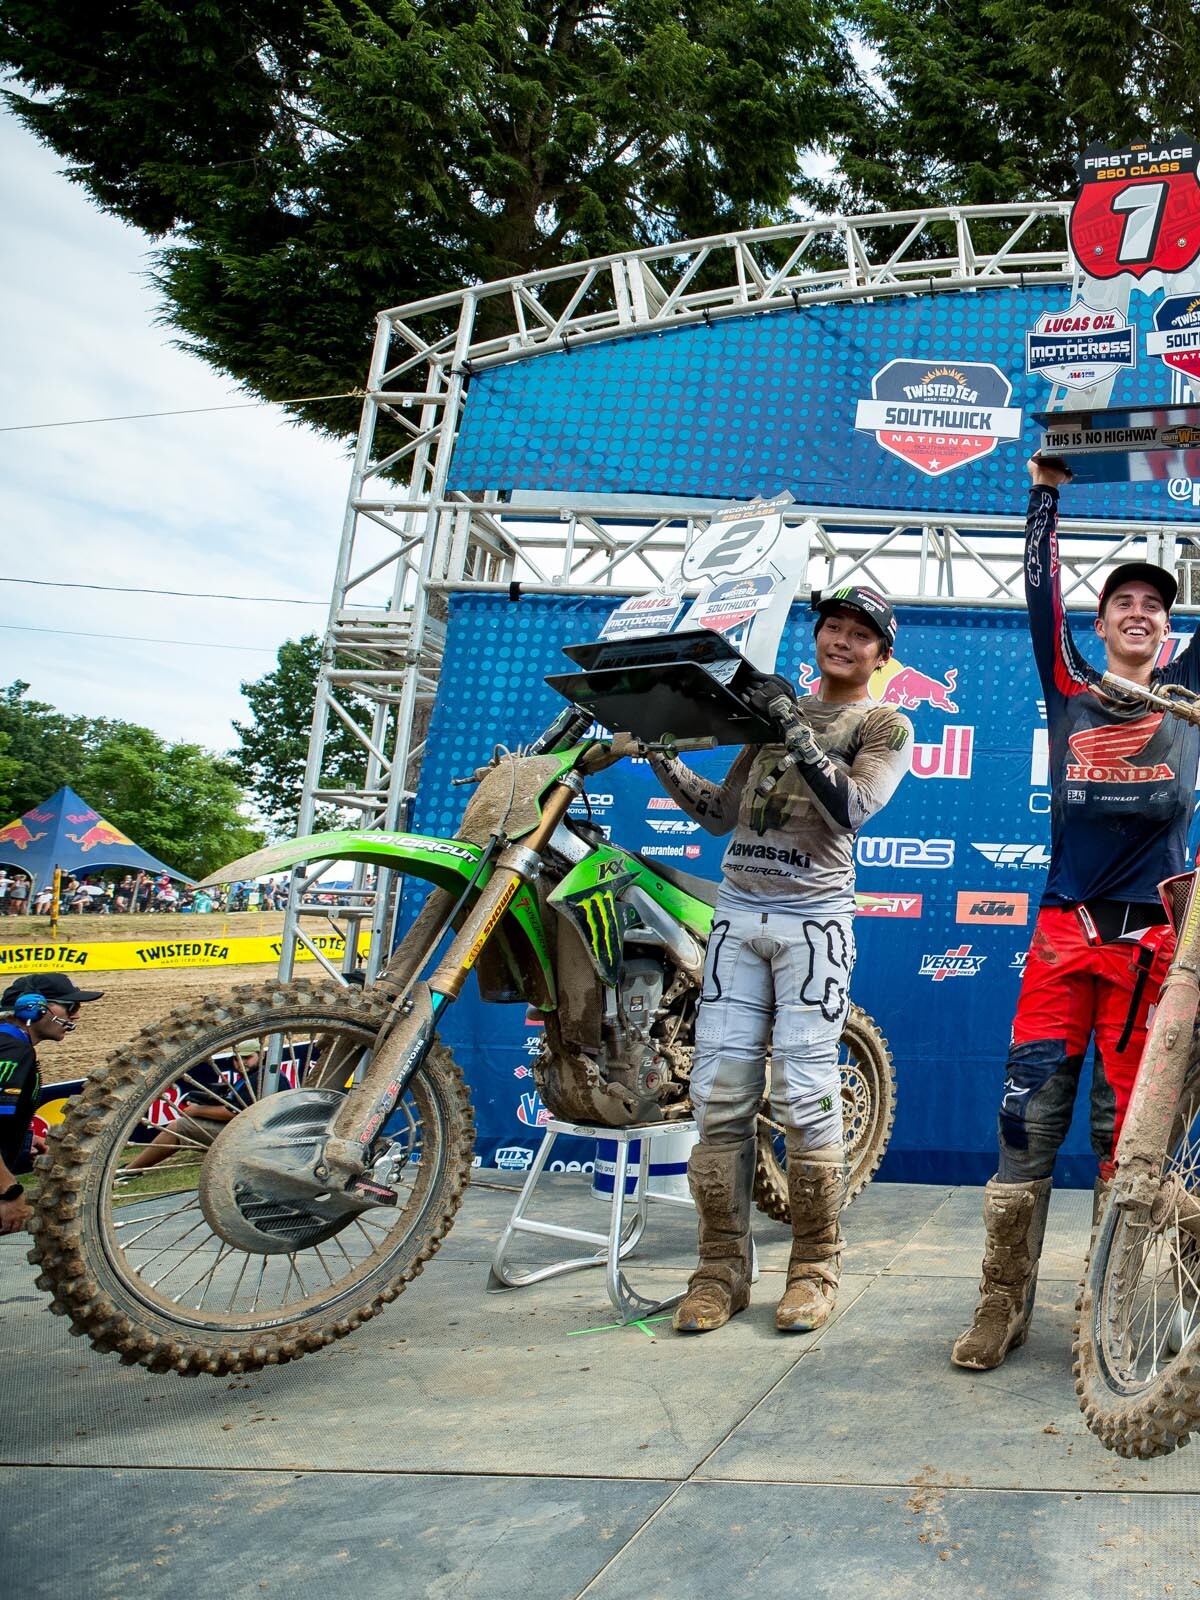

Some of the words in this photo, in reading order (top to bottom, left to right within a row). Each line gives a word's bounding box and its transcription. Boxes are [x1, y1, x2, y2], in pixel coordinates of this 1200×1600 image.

[1084, 154, 1132, 170] FIRST
[1138, 148, 1193, 163] PLACE
[1096, 169, 1126, 180] 250
[1130, 162, 1180, 176] CLASS
[1110, 181, 1170, 265] 1
[1044, 317, 1090, 333] LUCAS
[1093, 315, 1115, 330] OIL
[1031, 341, 1131, 358] MOTOCROSS
[1031, 352, 1131, 363] CHAMPIONSHIP
[903, 384, 954, 400] TWISTED
[955, 384, 979, 404] TEA
[885, 408, 993, 431] SOUTHWICK
[891, 434, 982, 447] NATIONAL
[1045, 431, 1070, 447] THIS
[1072, 431, 1082, 445] IS
[1086, 430, 1103, 444] NO
[1104, 428, 1158, 443] HIGHWAY
[717, 505, 756, 516] SECOND
[757, 499, 789, 509] PLACE
[698, 519, 766, 570] 2
[625, 598, 657, 611] LUCAS
[705, 599, 758, 614] SOUTHWICK
[608, 614, 674, 628] MOTOCROSS
[911, 727, 974, 778] ull
[1065, 763, 1176, 784] HONDA
[395, 837, 480, 864] CIRCUIT
[686, 847, 700, 855] Rate
[727, 840, 813, 869] Kawasaki
[859, 838, 953, 866] WPS
[744, 865, 801, 879] CIRCUIT
[483, 882, 516, 937] SHOWA
[968, 900, 1016, 917] KTM
[58, 947, 88, 966] TEA
[136, 944, 201, 963] TWISTED
[203, 943, 229, 960] TEA
[921, 955, 983, 970] VERTEX
[396, 1038, 425, 1082] PISTONS
